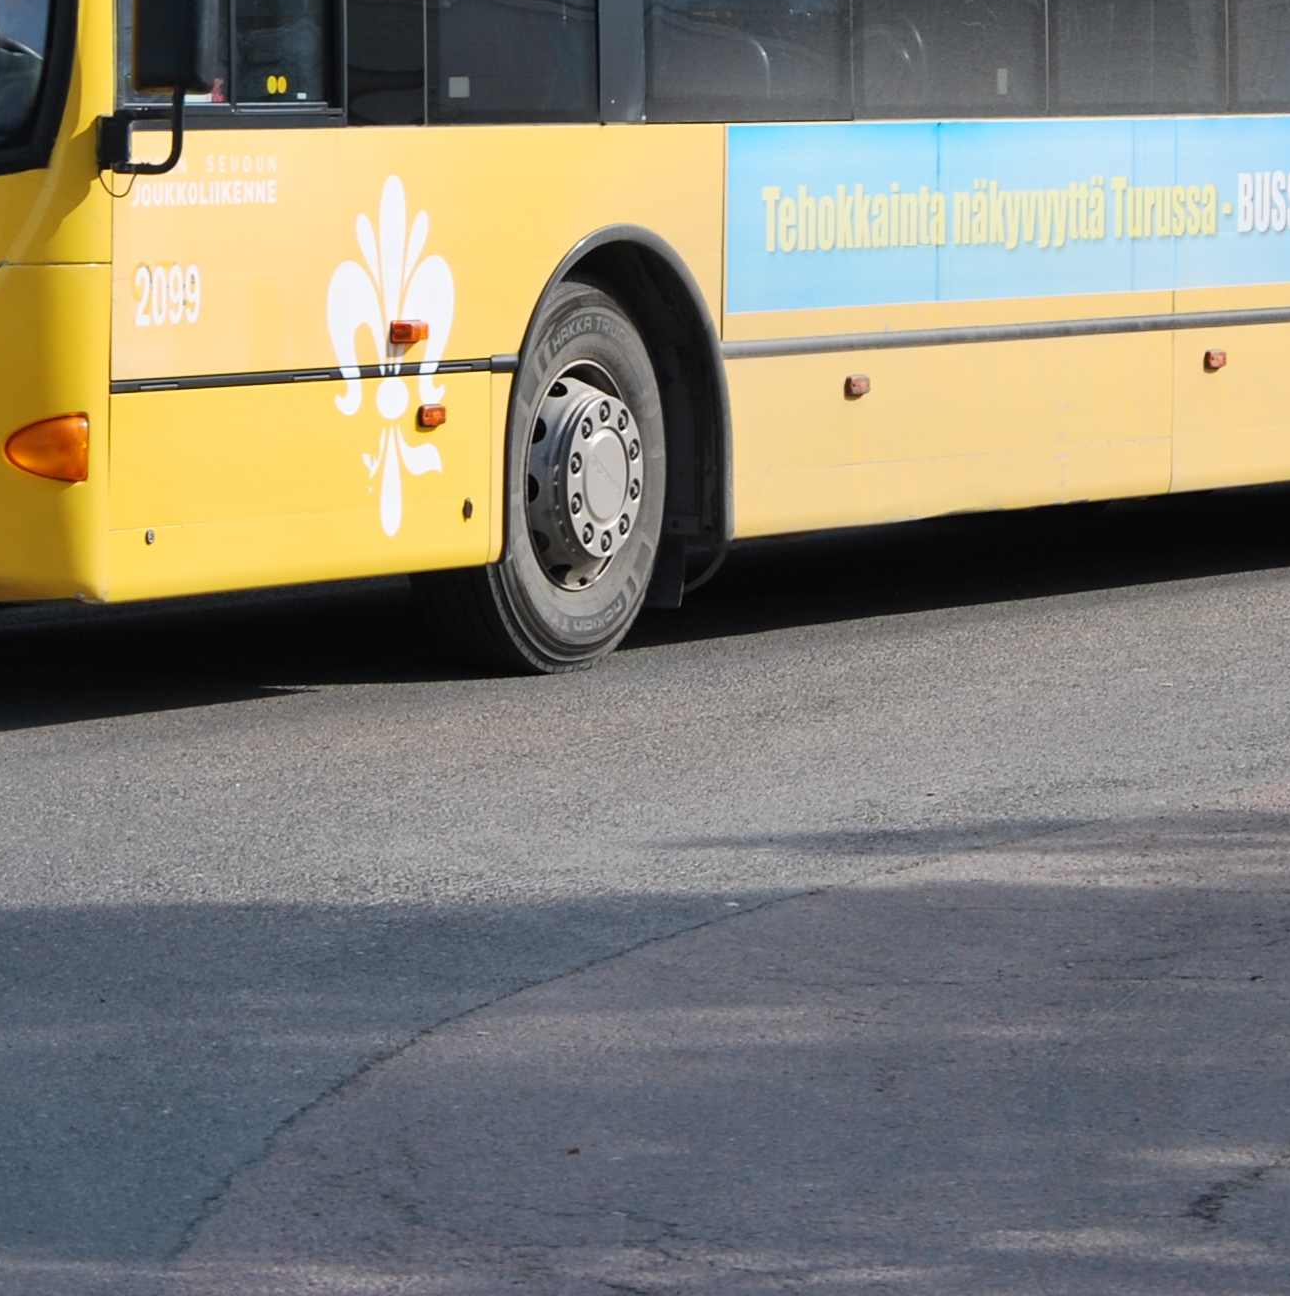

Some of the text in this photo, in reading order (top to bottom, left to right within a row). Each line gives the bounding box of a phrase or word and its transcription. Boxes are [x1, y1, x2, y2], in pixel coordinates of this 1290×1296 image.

[206, 154, 277, 174] SEUDUN
[131, 179, 278, 207] JOUKKOLIIKENNE
[762, 182, 947, 253] Tehokkainta
[953, 175, 1107, 250] näkyvyyttä
[1111, 176, 1219, 239] Turussa
[134, 263, 201, 326] 2099
